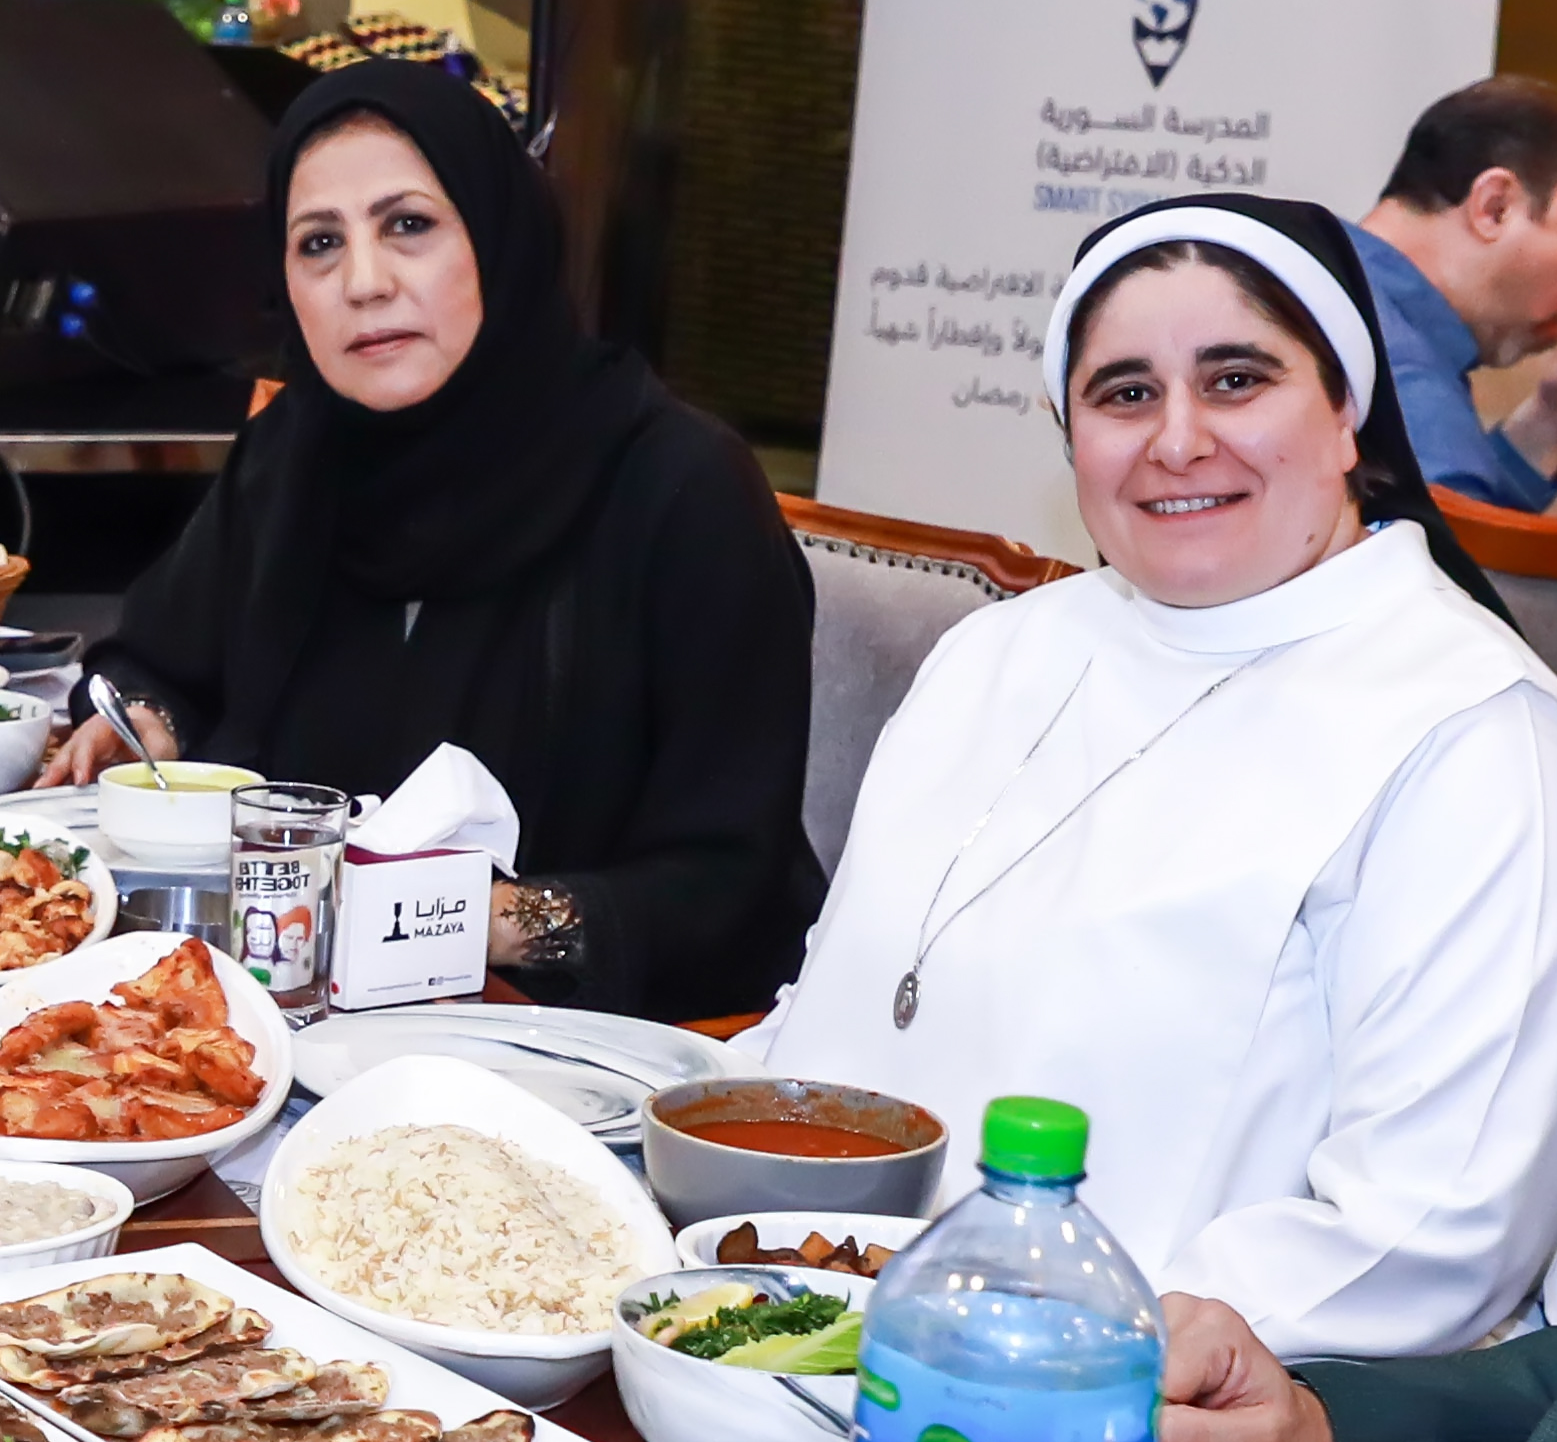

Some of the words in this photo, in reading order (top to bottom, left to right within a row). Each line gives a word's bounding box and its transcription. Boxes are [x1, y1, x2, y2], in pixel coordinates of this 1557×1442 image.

[1163, 106, 1271, 144] المدرسة
[415, 897, 467, 922] مزايا
[413, 921, 466, 939] MAZAYA
